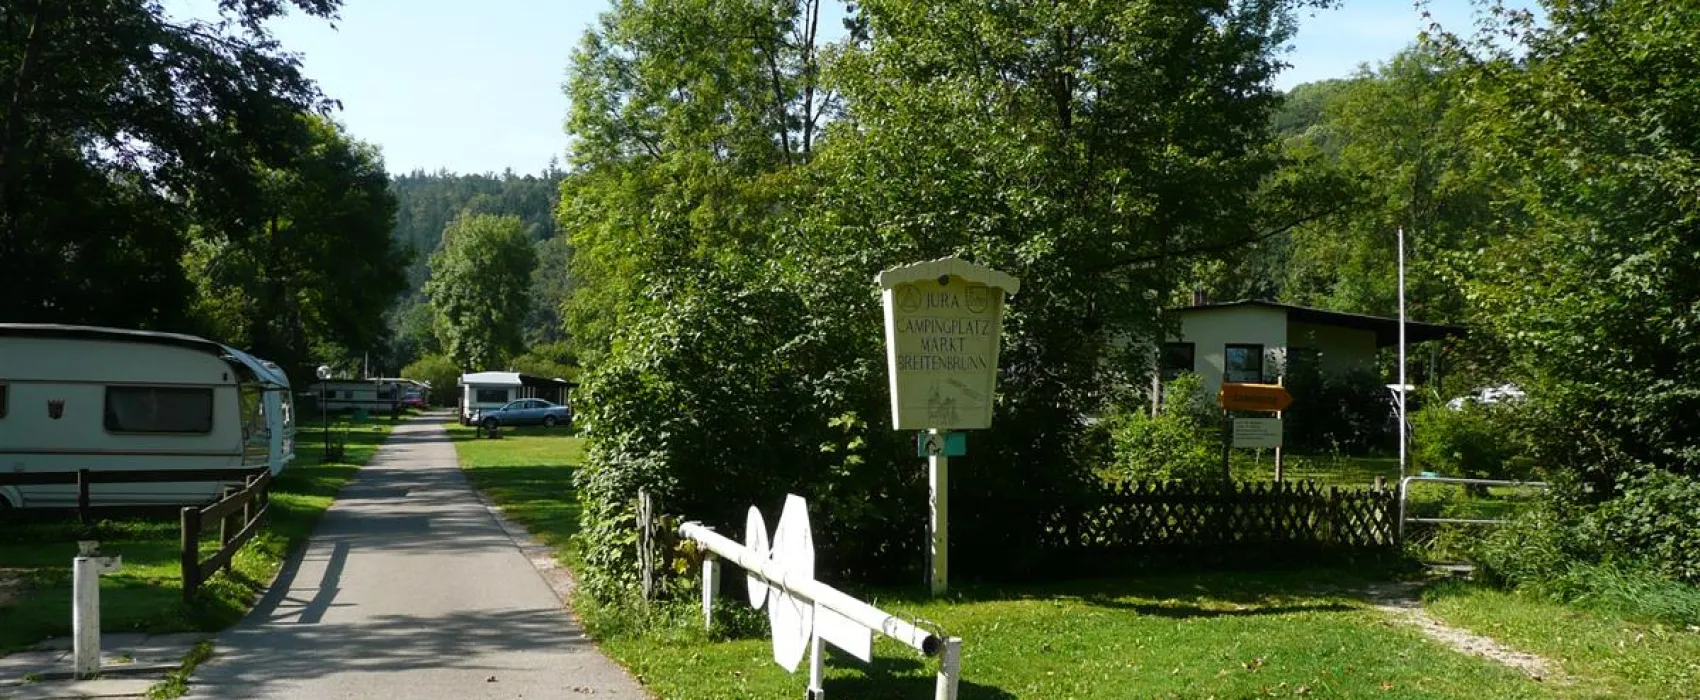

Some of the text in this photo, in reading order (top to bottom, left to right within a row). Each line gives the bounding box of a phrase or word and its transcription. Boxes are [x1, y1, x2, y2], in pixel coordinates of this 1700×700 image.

[927, 292, 960, 308] JURA
[897, 318, 991, 336] CAMPINGPLATZ
[921, 336, 965, 352] MARKT
[897, 354, 988, 371] BREITENBRUNN
